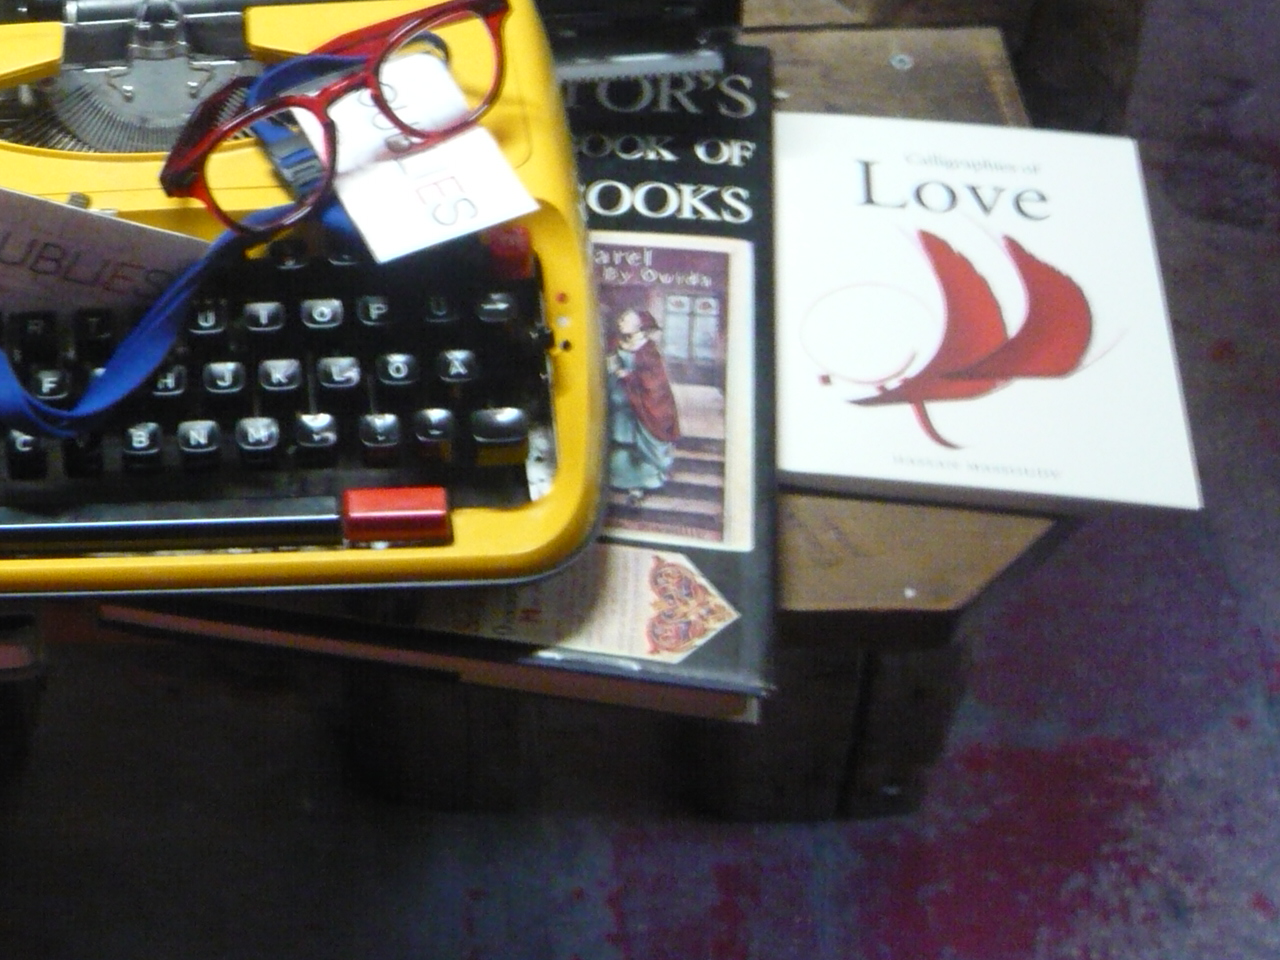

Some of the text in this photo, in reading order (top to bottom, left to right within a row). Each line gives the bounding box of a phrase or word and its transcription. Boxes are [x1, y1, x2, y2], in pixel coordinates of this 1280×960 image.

[694, 140, 756, 167] OF
[579, 179, 754, 224] OOKS
[855, 159, 1052, 222] Love
